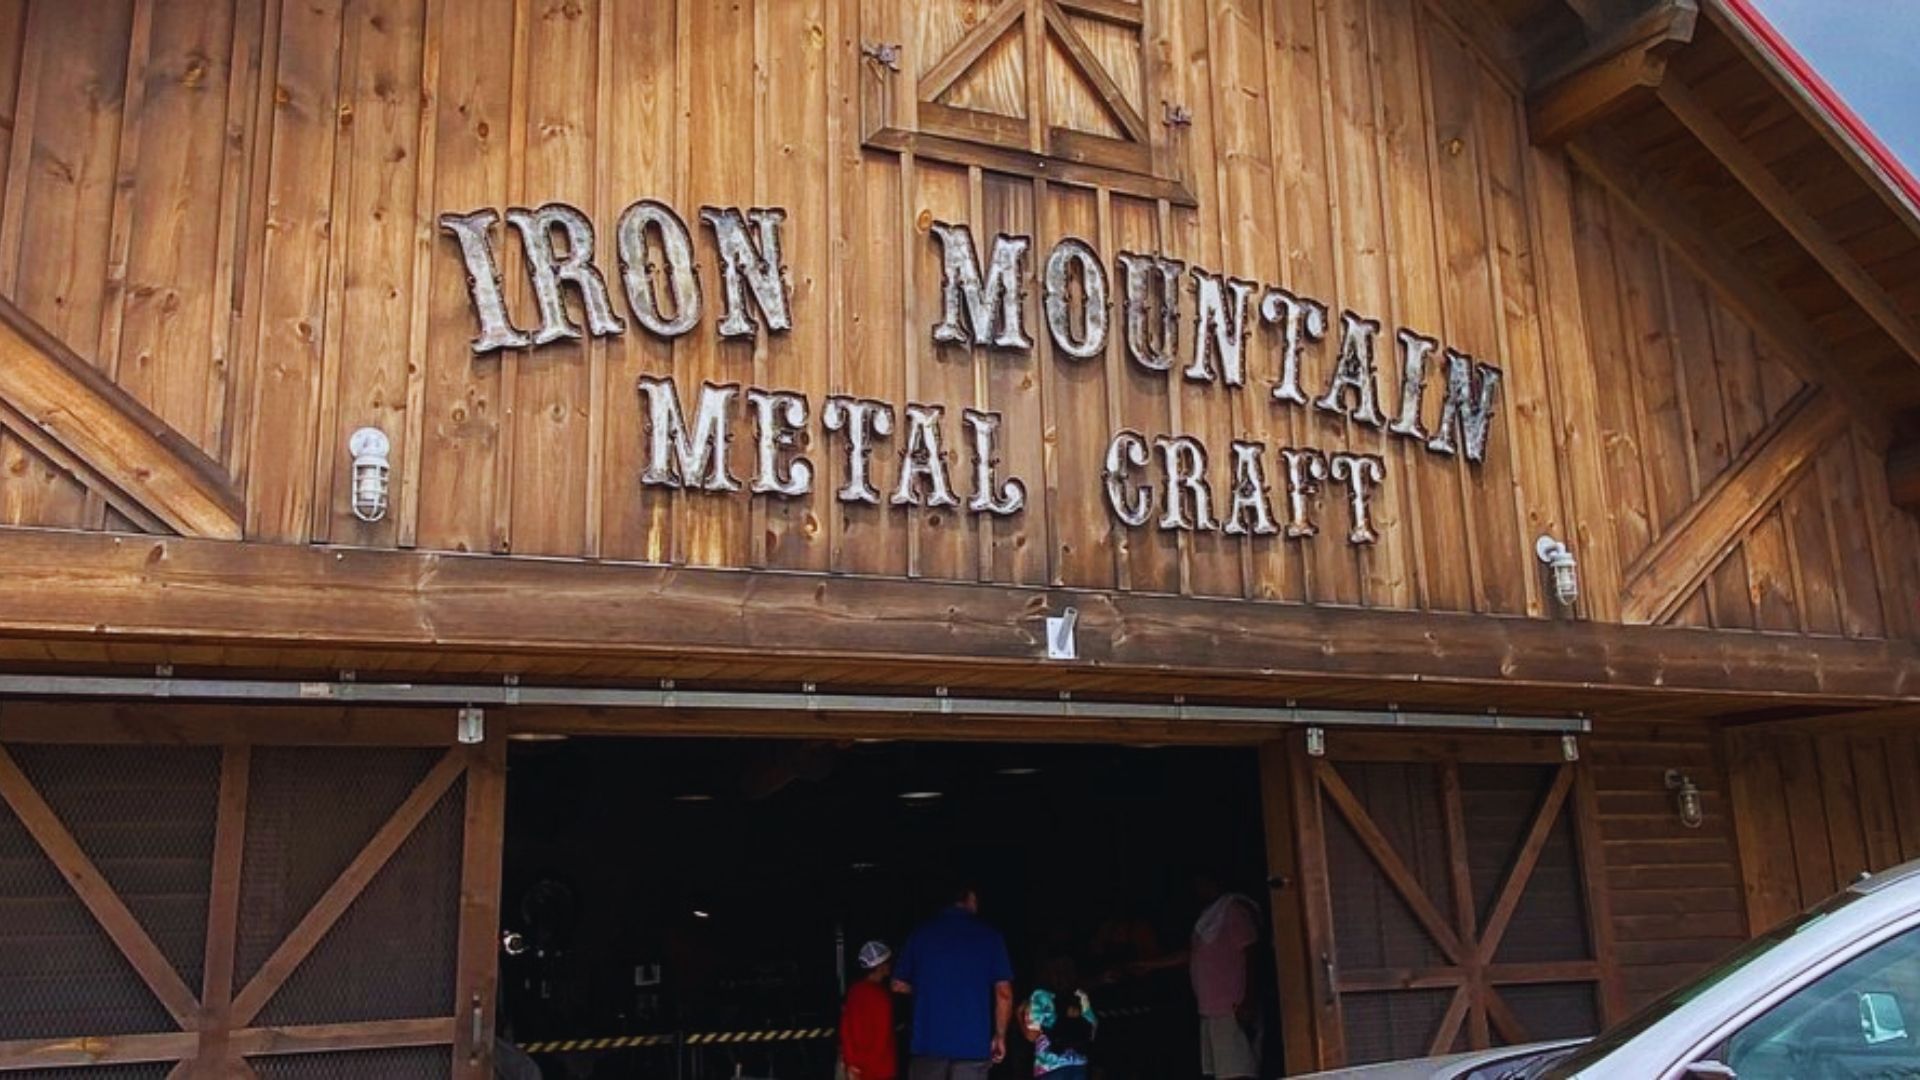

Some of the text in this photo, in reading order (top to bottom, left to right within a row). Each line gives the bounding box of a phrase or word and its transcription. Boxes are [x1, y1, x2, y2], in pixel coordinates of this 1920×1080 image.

[440, 199, 1503, 465] IRON MOUNTAIN
[638, 374, 1386, 546] METAL CRAFT
